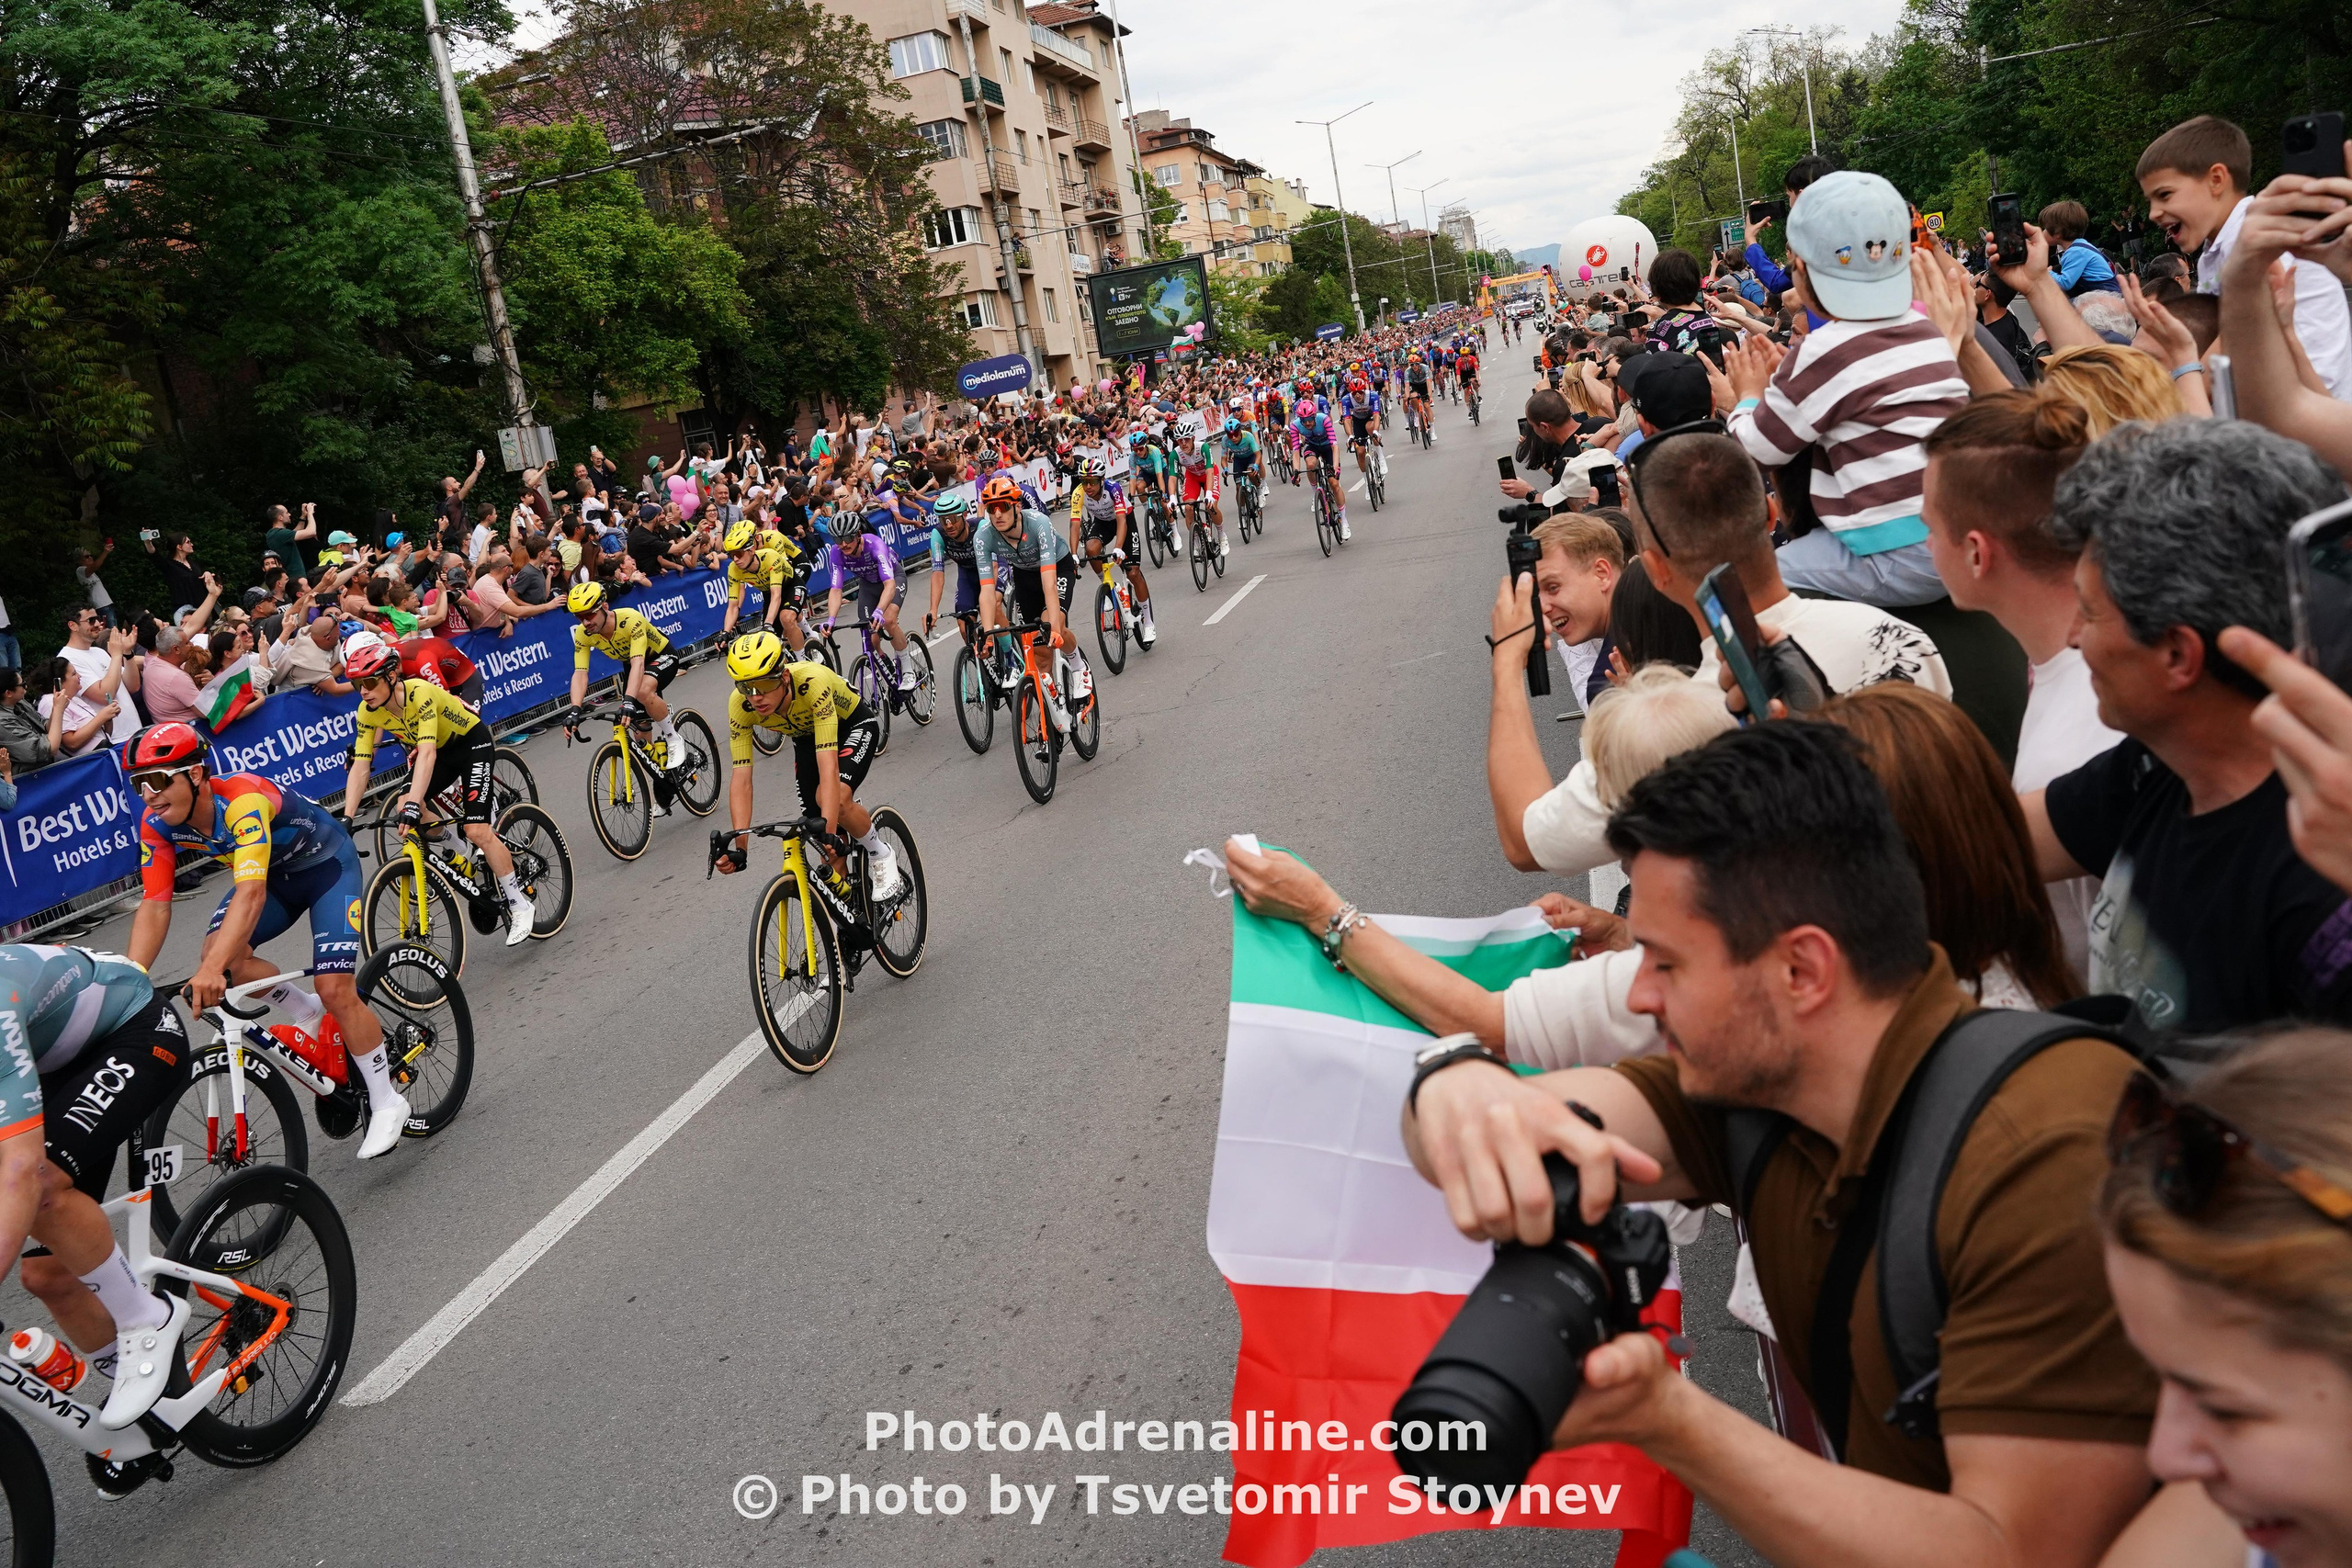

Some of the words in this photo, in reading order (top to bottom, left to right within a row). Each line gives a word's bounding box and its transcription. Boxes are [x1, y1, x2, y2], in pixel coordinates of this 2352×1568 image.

[1929, 218, 1939, 227] 80
[1106, 303, 1143, 315] ОТГОВОРНИ
[1114, 316, 1139, 326] ЗАЕДНО
[965, 367, 1026, 387] mediolanum
[878, 523, 896, 546] BW
[1038, 525, 1048, 550] INEOS
[1131, 532, 1140, 556] INEOS
[976, 537, 987, 564] INEOS
[872, 649, 898, 685] GIANT
[481, 683, 503, 706] otels
[504, 682, 512, 696] &
[511, 671, 544, 694] Resorts
[418, 698, 434, 714] VISMA
[440, 705, 470, 728] Rabobank
[151, 722, 180, 740] TREK
[222, 733, 274, 773] Best
[277, 710, 359, 759] Wester
[303, 761, 316, 778] &
[469, 761, 484, 788] VISMA
[17, 800, 84, 853] Best
[171, 831, 203, 842] Santini
[53, 835, 113, 874] Hotels
[113, 829, 130, 851] &
[232, 867, 266, 879] CRIVIT
[428, 853, 481, 897] cervélo
[809, 870, 855, 925] cervélo
[512, 927, 531, 944] nimbl
[388, 948, 448, 980] AEOLUS
[190, 1051, 272, 1080] AEOUS
[62, 1055, 136, 1135] INEOS
[404, 1118, 430, 1131] RSL
[152, 1150, 174, 1184] 95
[217, 1248, 252, 1265] RSL
